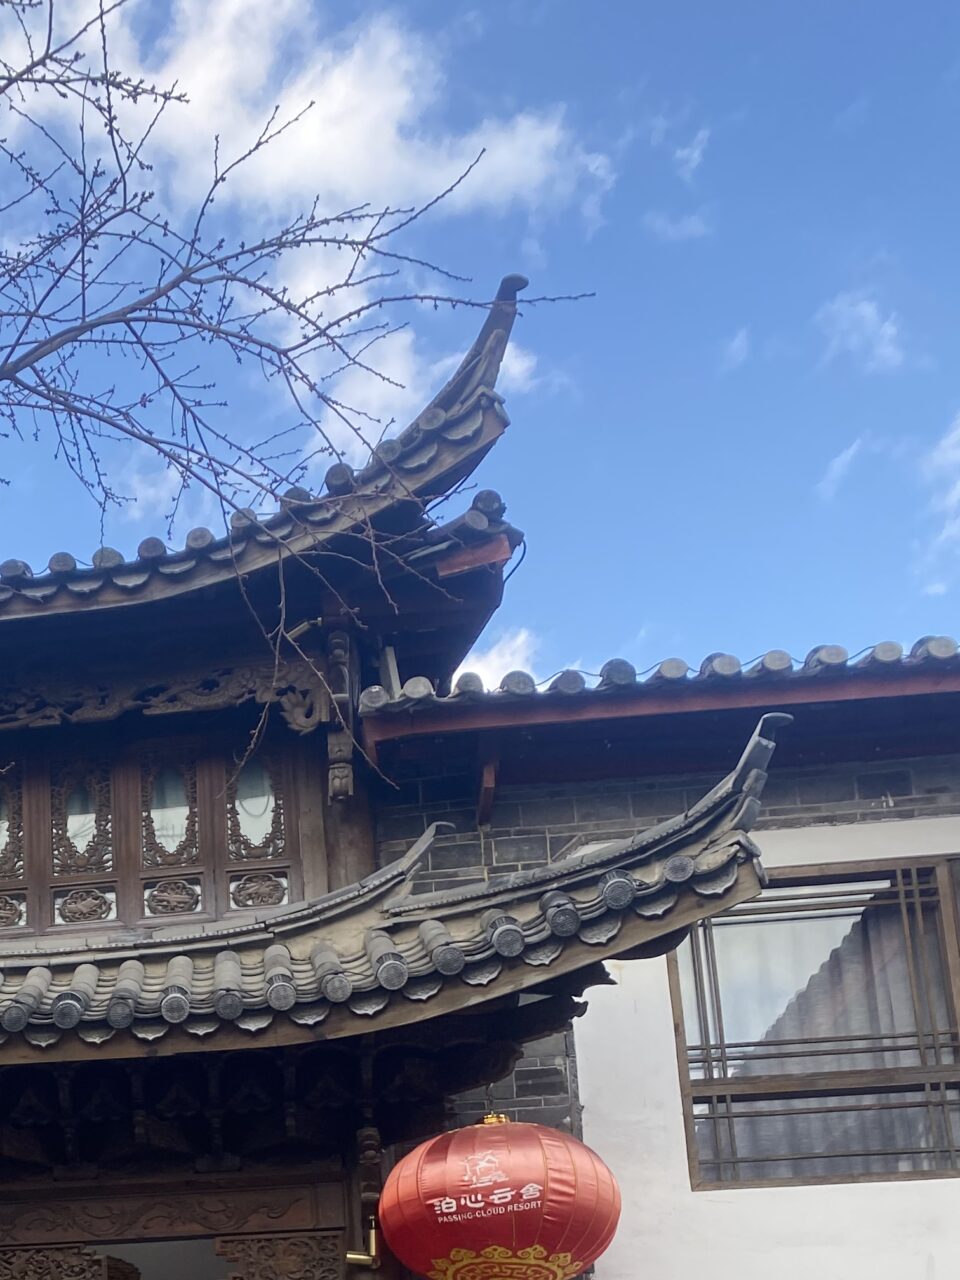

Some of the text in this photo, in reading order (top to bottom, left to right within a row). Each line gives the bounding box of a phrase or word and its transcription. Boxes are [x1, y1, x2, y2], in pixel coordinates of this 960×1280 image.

[433, 1182, 543, 1213] 泊心云舍
[438, 1200, 542, 1223] PASSING-CLOUD RESORT
